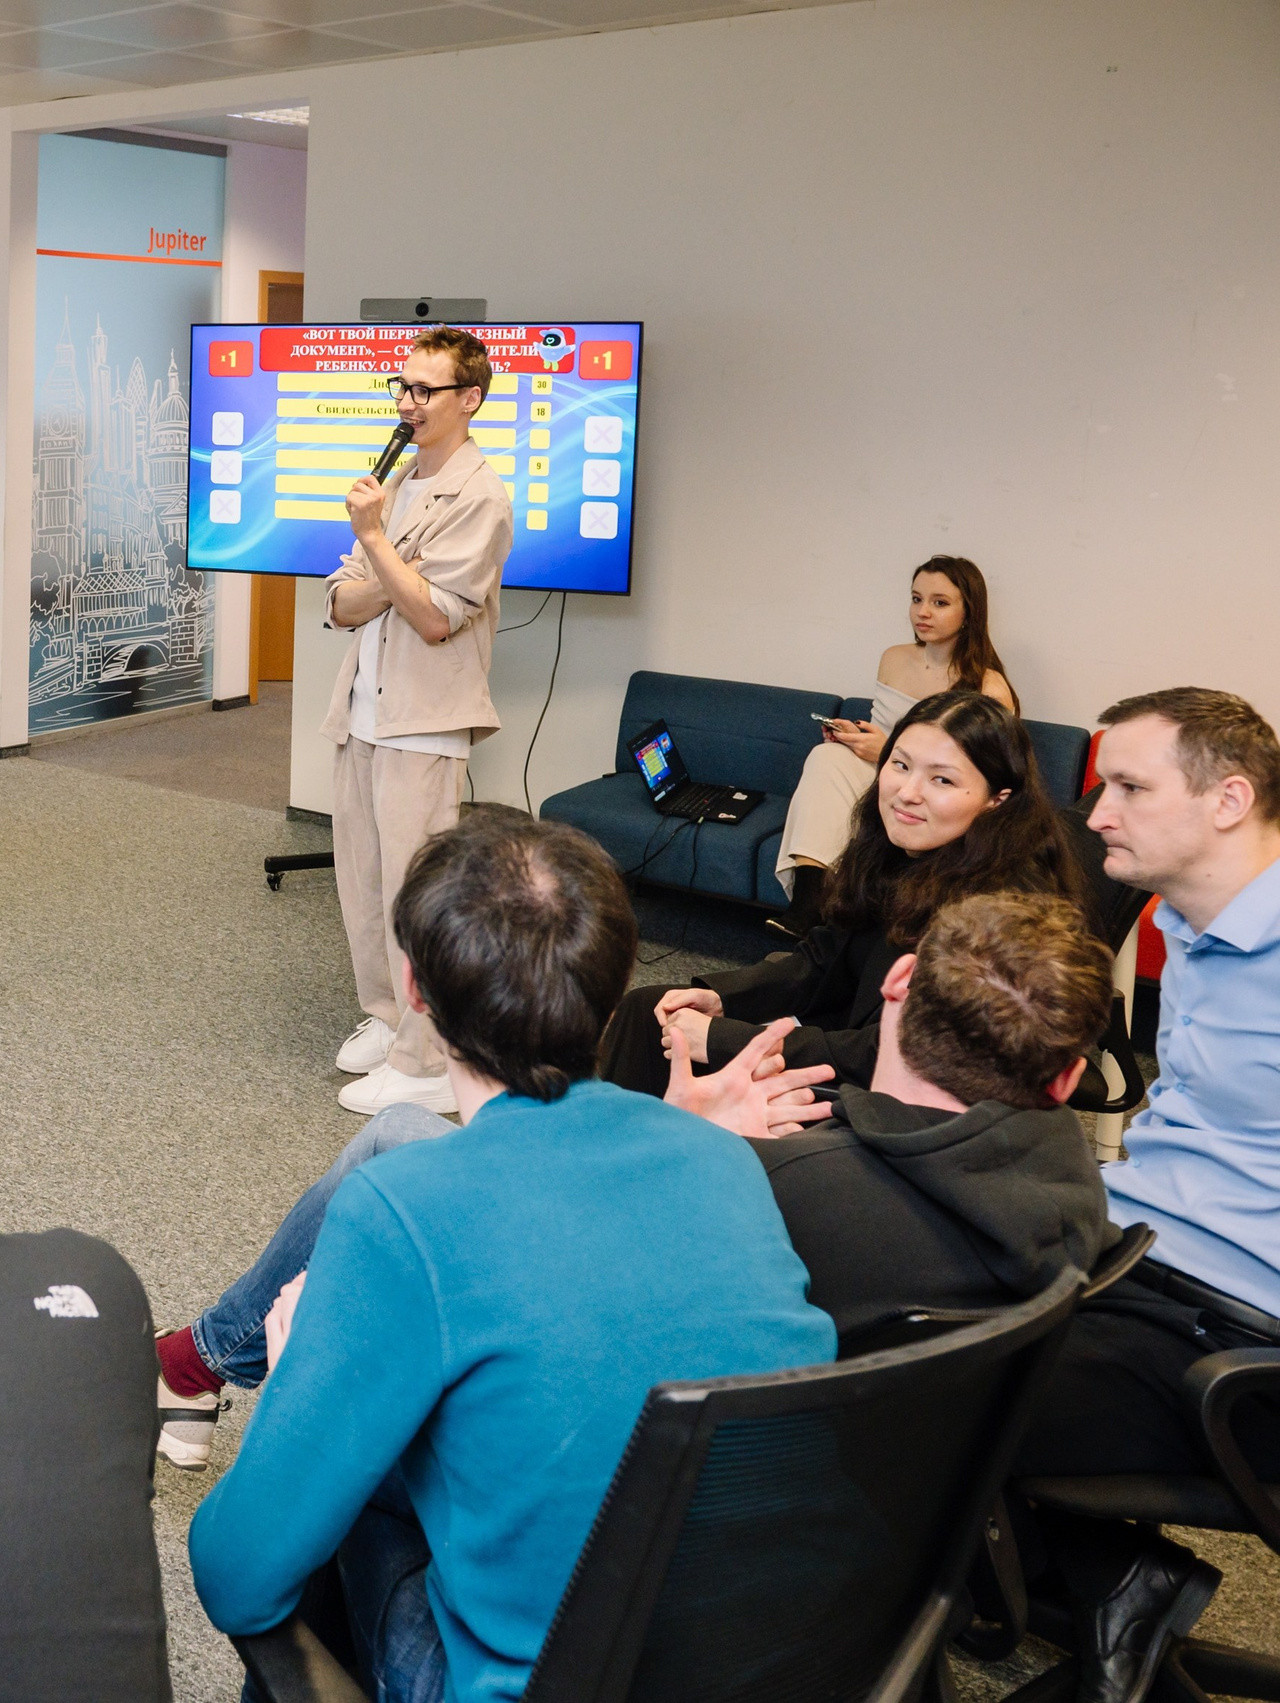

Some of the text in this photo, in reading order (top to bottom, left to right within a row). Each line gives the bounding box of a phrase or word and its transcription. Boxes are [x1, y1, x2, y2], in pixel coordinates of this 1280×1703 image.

[147, 227, 207, 255] Jupiter
[303, 329, 336, 340] «ВОТ
[338, 326, 375, 340] ТВОЙ
[290, 345, 376, 358] ДОКУМЕНТ»,
[315, 360, 378, 371] РЕБЕНКУ.
[380, 360, 391, 371] О
[537, 381, 547, 389] 30
[536, 408, 545, 416] 18
